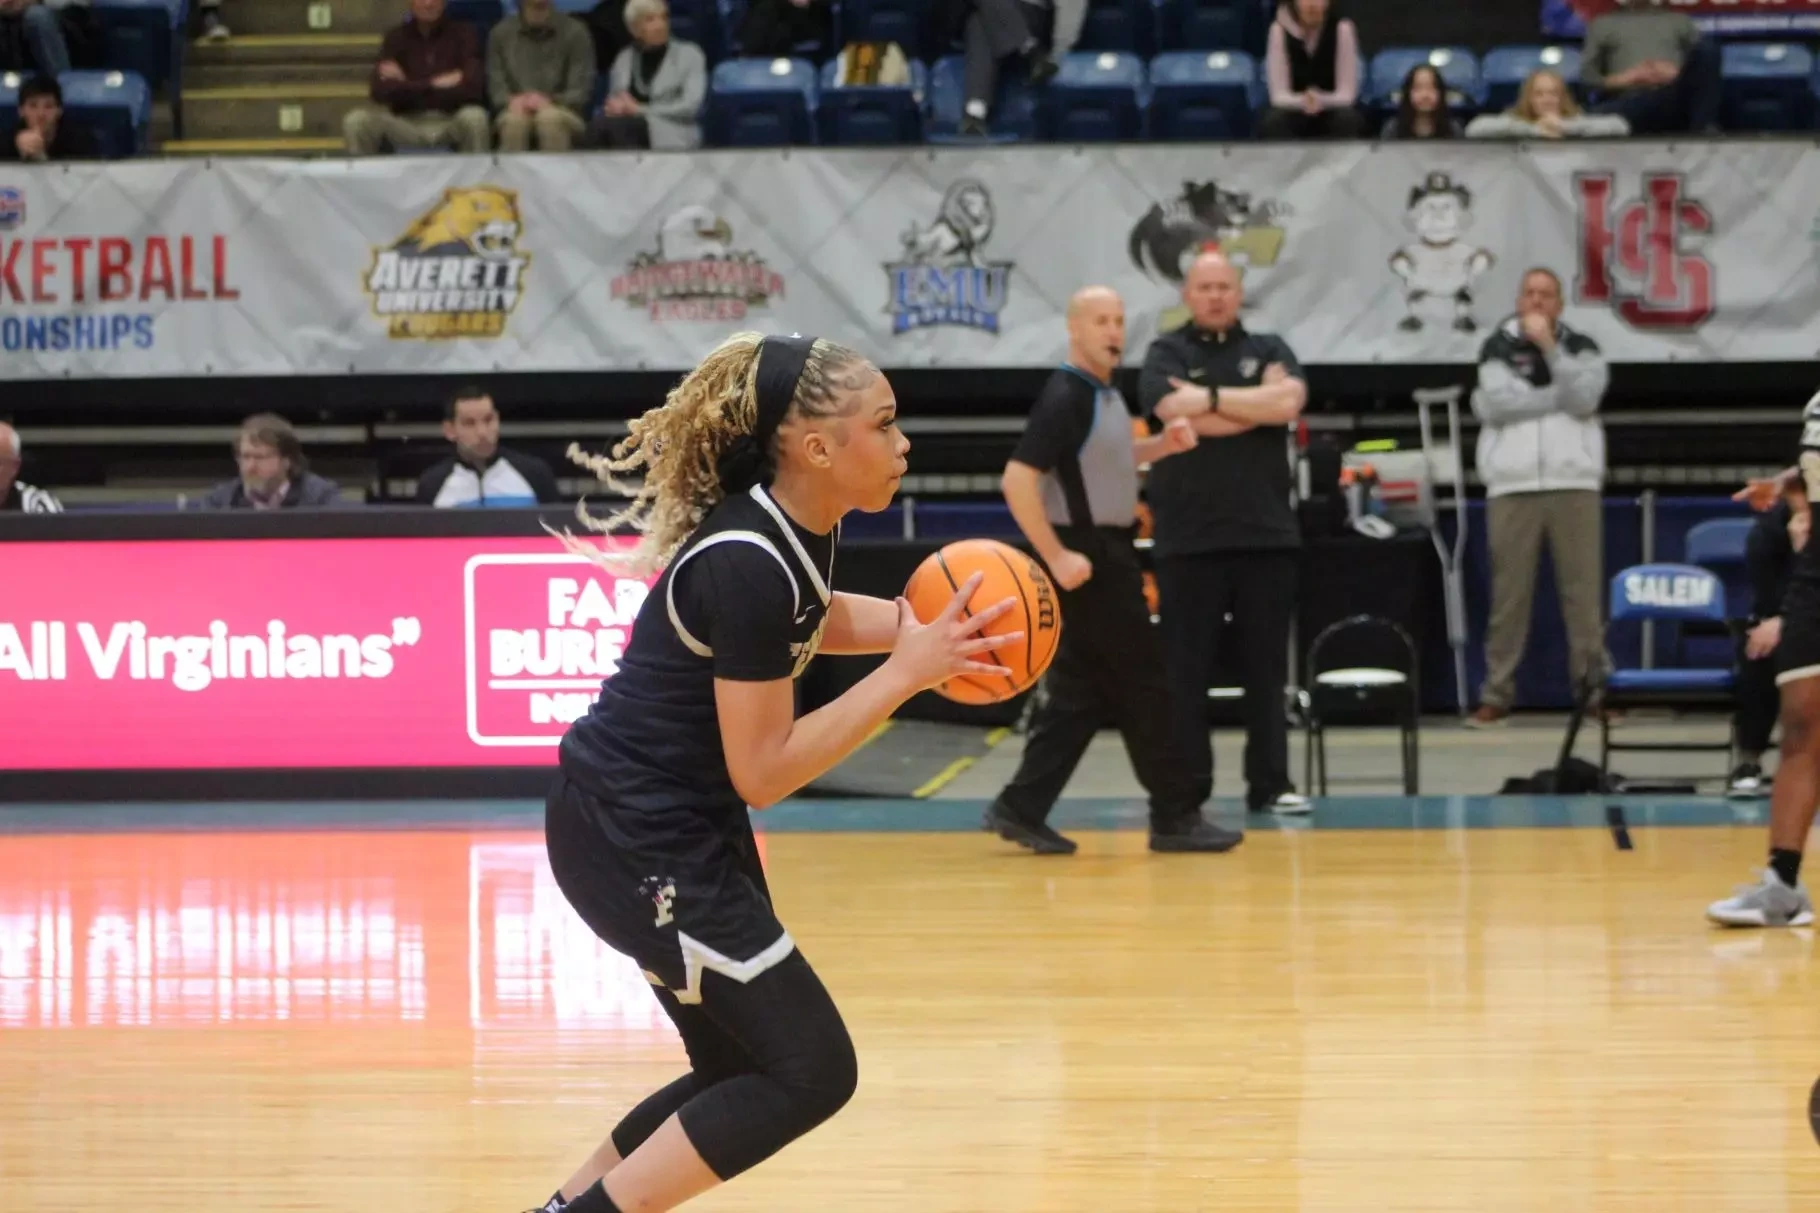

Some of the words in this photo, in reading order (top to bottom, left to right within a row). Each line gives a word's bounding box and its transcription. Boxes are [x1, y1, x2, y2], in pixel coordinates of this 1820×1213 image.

[370, 251, 526, 291] AVERETT
[1623, 573, 1716, 607] SALEM
[0, 620, 67, 680] All
